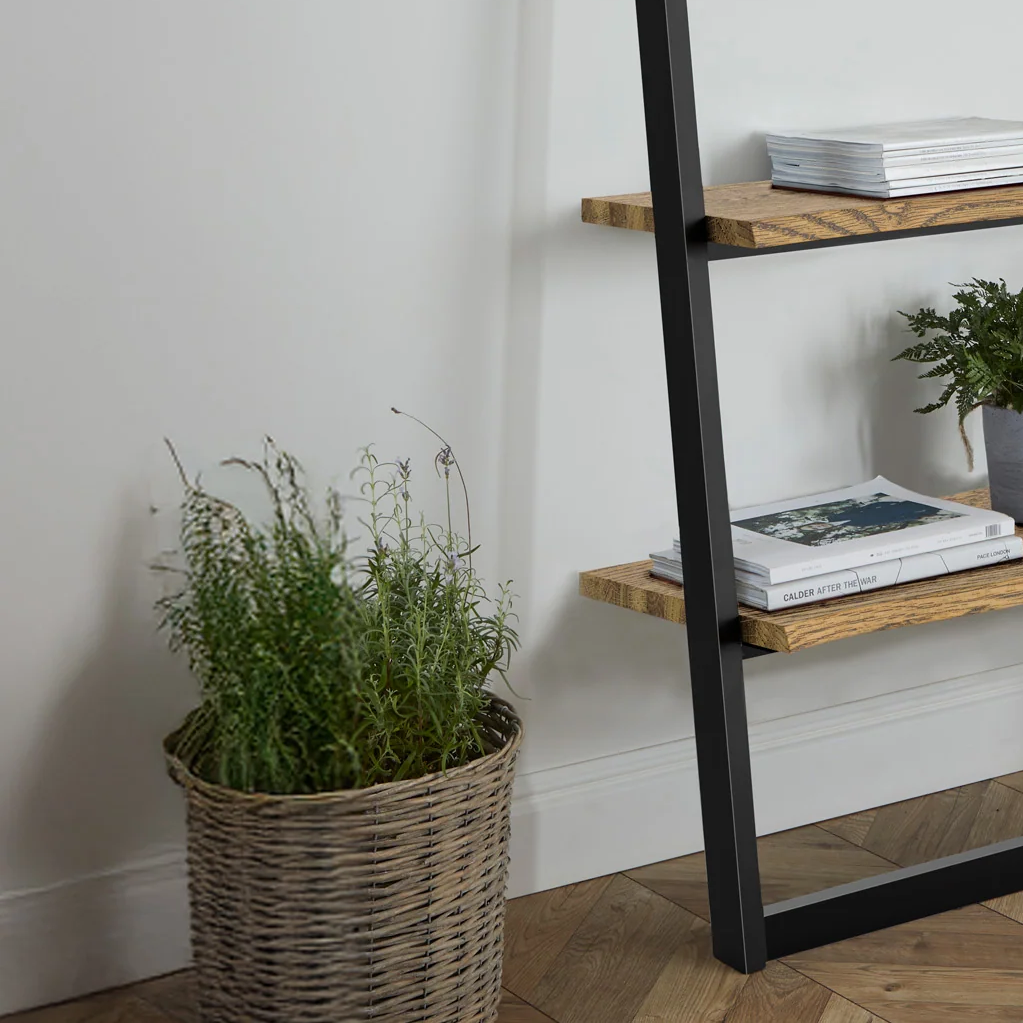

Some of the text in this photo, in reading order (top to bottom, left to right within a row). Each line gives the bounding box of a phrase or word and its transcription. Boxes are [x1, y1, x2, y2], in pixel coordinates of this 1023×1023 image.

[977, 549, 1011, 560] PACE LONDON
[783, 575, 877, 602] CALDER AFTER THE WAR
